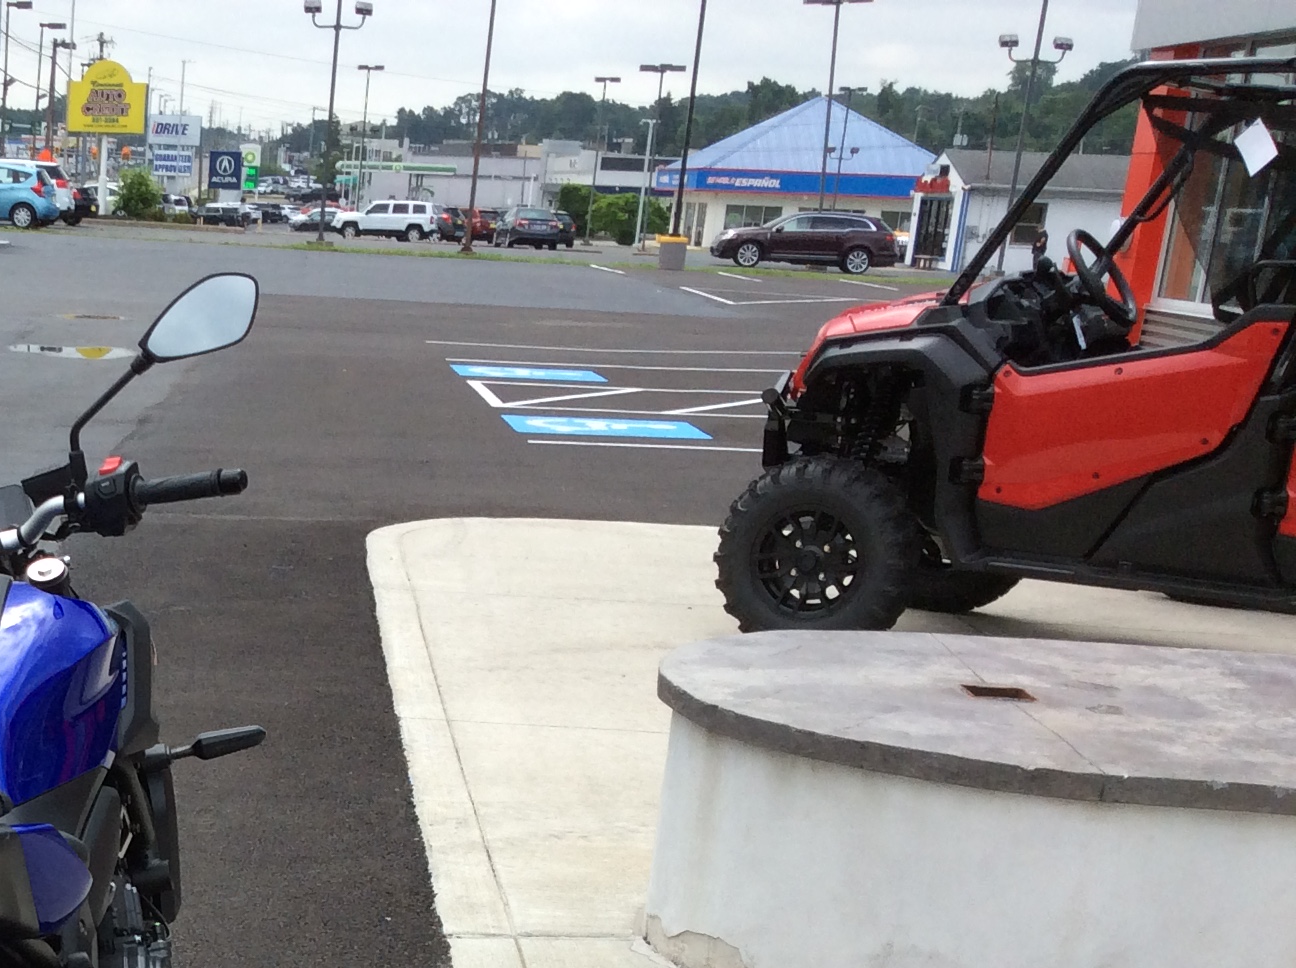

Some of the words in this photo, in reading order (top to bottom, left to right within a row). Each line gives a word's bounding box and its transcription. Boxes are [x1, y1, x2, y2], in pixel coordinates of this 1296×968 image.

[87, 88, 127, 103] AUTO
[81, 102, 131, 117] CREDIT
[734, 177, 781, 188] ESPAÑOL
